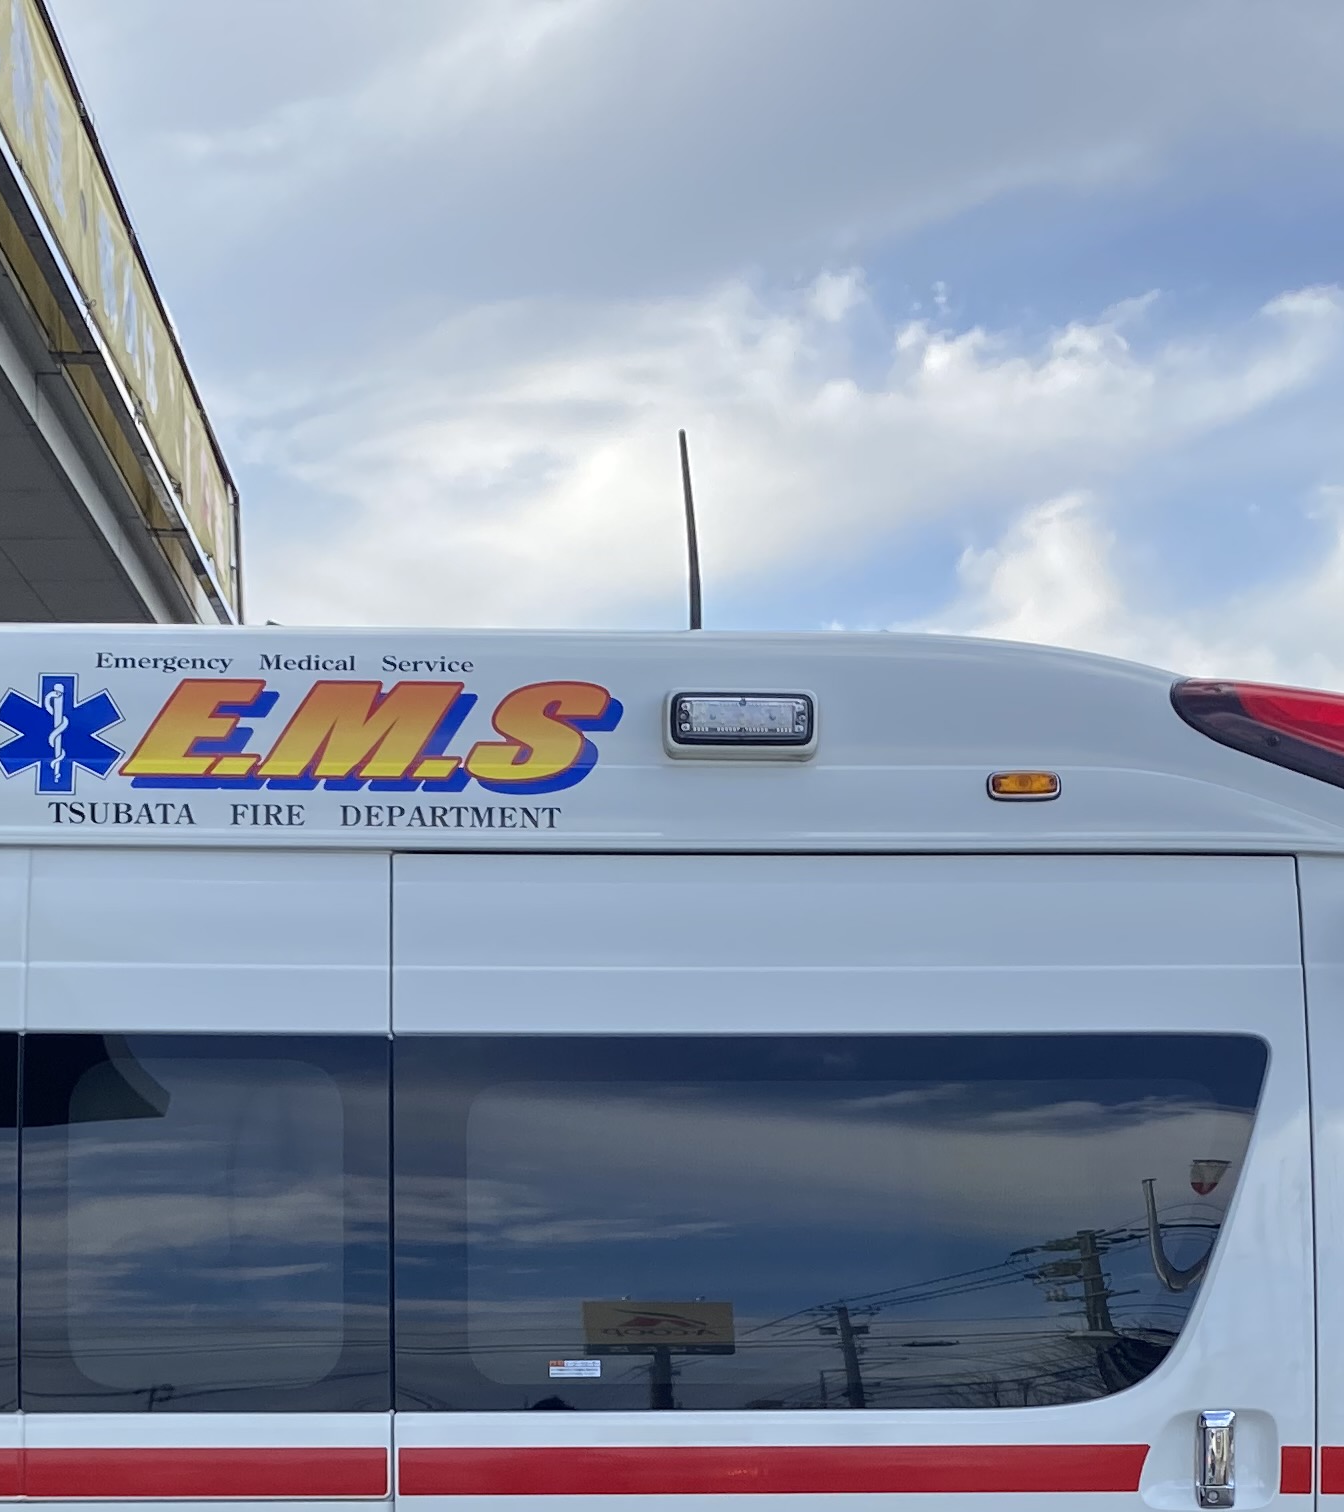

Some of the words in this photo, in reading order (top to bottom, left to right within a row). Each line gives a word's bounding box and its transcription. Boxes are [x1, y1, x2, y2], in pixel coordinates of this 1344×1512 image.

[95, 653, 233, 674] Emergency
[259, 654, 356, 672] Medical
[381, 655, 474, 673] Service
[47, 802, 197, 826] TSUBATA
[229, 803, 306, 826] FIRE
[340, 804, 563, 830] DEPARTMENT
